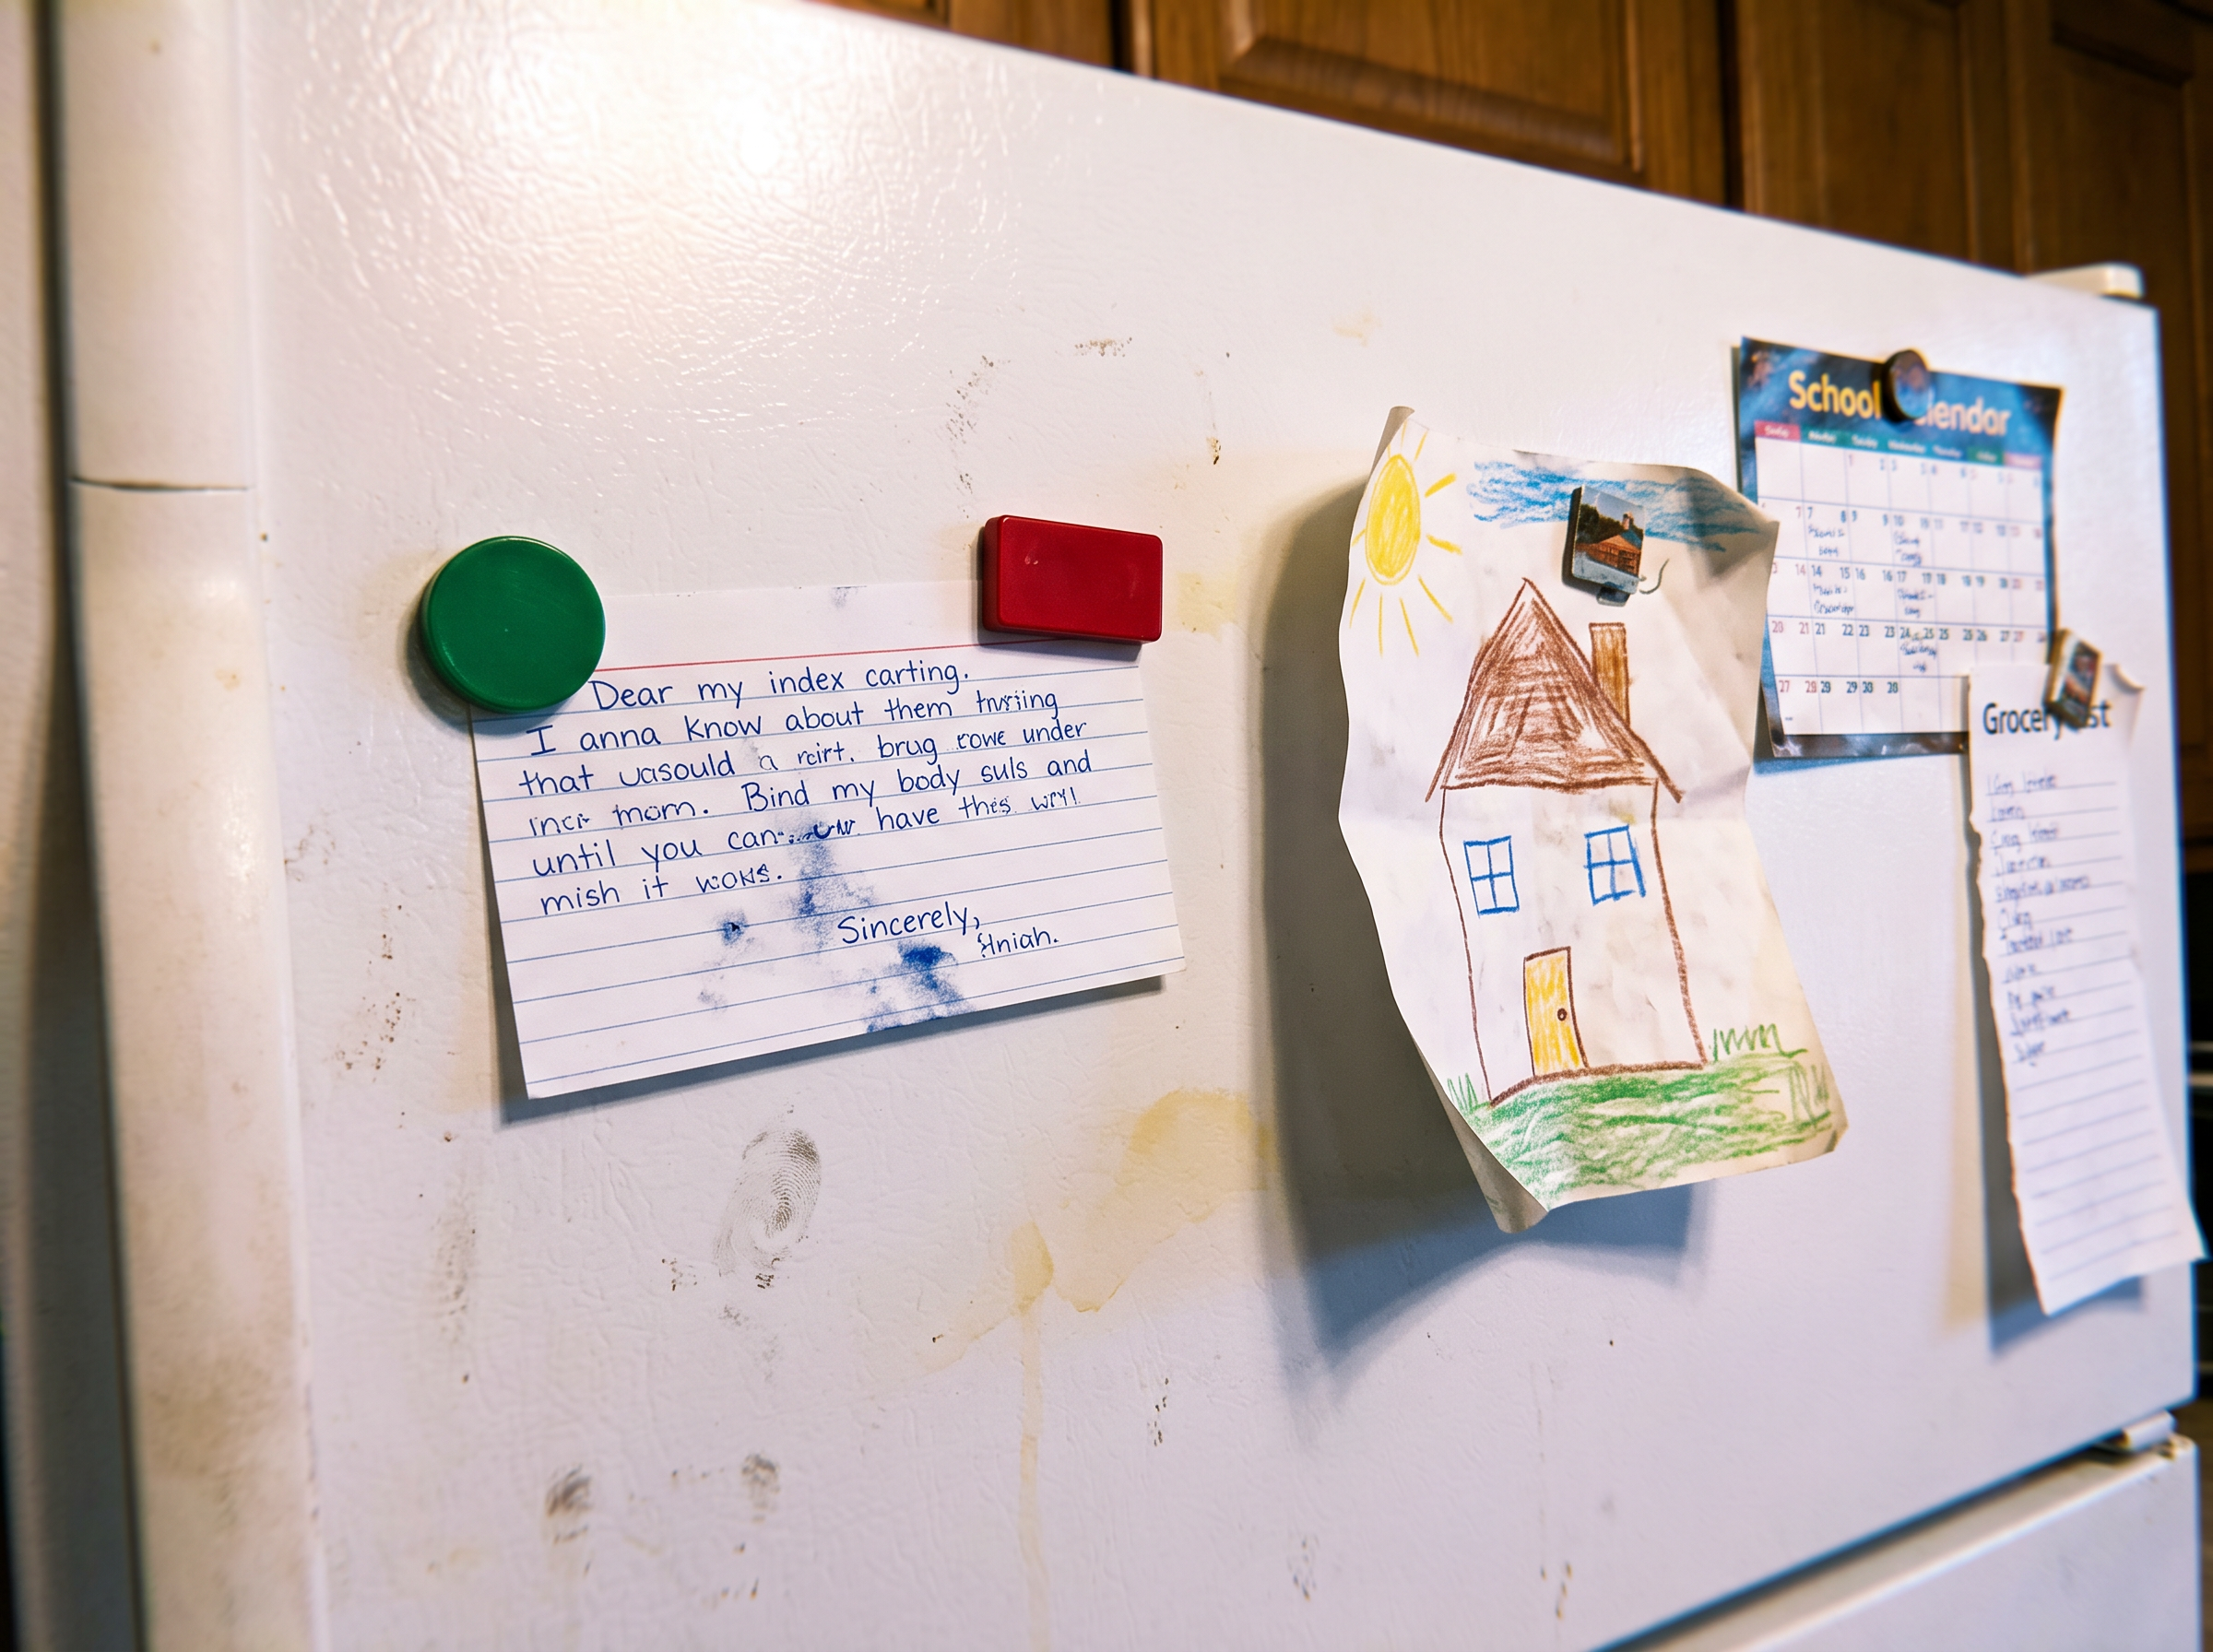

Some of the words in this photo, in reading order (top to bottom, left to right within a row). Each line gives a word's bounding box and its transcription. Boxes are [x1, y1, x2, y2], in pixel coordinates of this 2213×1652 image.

[1789, 370, 1882, 419] School
[1913, 396, 2011, 436] endar
[1807, 506, 1814, 519] 7
[1795, 563, 1806, 576] 14
[1811, 564, 1822, 577] 14
[1840, 567, 1851, 580] 15
[1855, 568, 1865, 581] 16
[1882, 570, 1893, 582] 16
[1897, 571, 1907, 583] 17
[1799, 621, 1809, 635] 21
[1815, 622, 1826, 635] 21
[1841, 623, 1854, 636] 22
[1859, 624, 1870, 637] 23
[1884, 626, 1896, 638] 23
[1899, 627, 1911, 640] 24
[588, 680, 673, 710] Dear
[698, 681, 742, 709] my
[769, 667, 845, 694] index
[866, 660, 968, 694] carting.
[1779, 679, 1790, 693] 27
[526, 725, 556, 756] I
[580, 726, 661, 751] anna
[684, 714, 762, 741] know
[786, 702, 864, 732] about
[884, 698, 953, 721] them
[519, 764, 594, 796] that
[759, 754, 778, 771] a
[878, 735, 938, 765] brug
[1023, 719, 1087, 744] under
[741, 780, 811, 812] Bind
[832, 780, 875, 808] my
[896, 764, 960, 796] body
[1047, 749, 1093, 777] and
[532, 839, 616, 877] until
[641, 840, 703, 873] you
[875, 807, 941, 831] have
[540, 879, 621, 915] mish
[642, 875, 669, 900] it
[837, 901, 981, 945] Sincerely,
